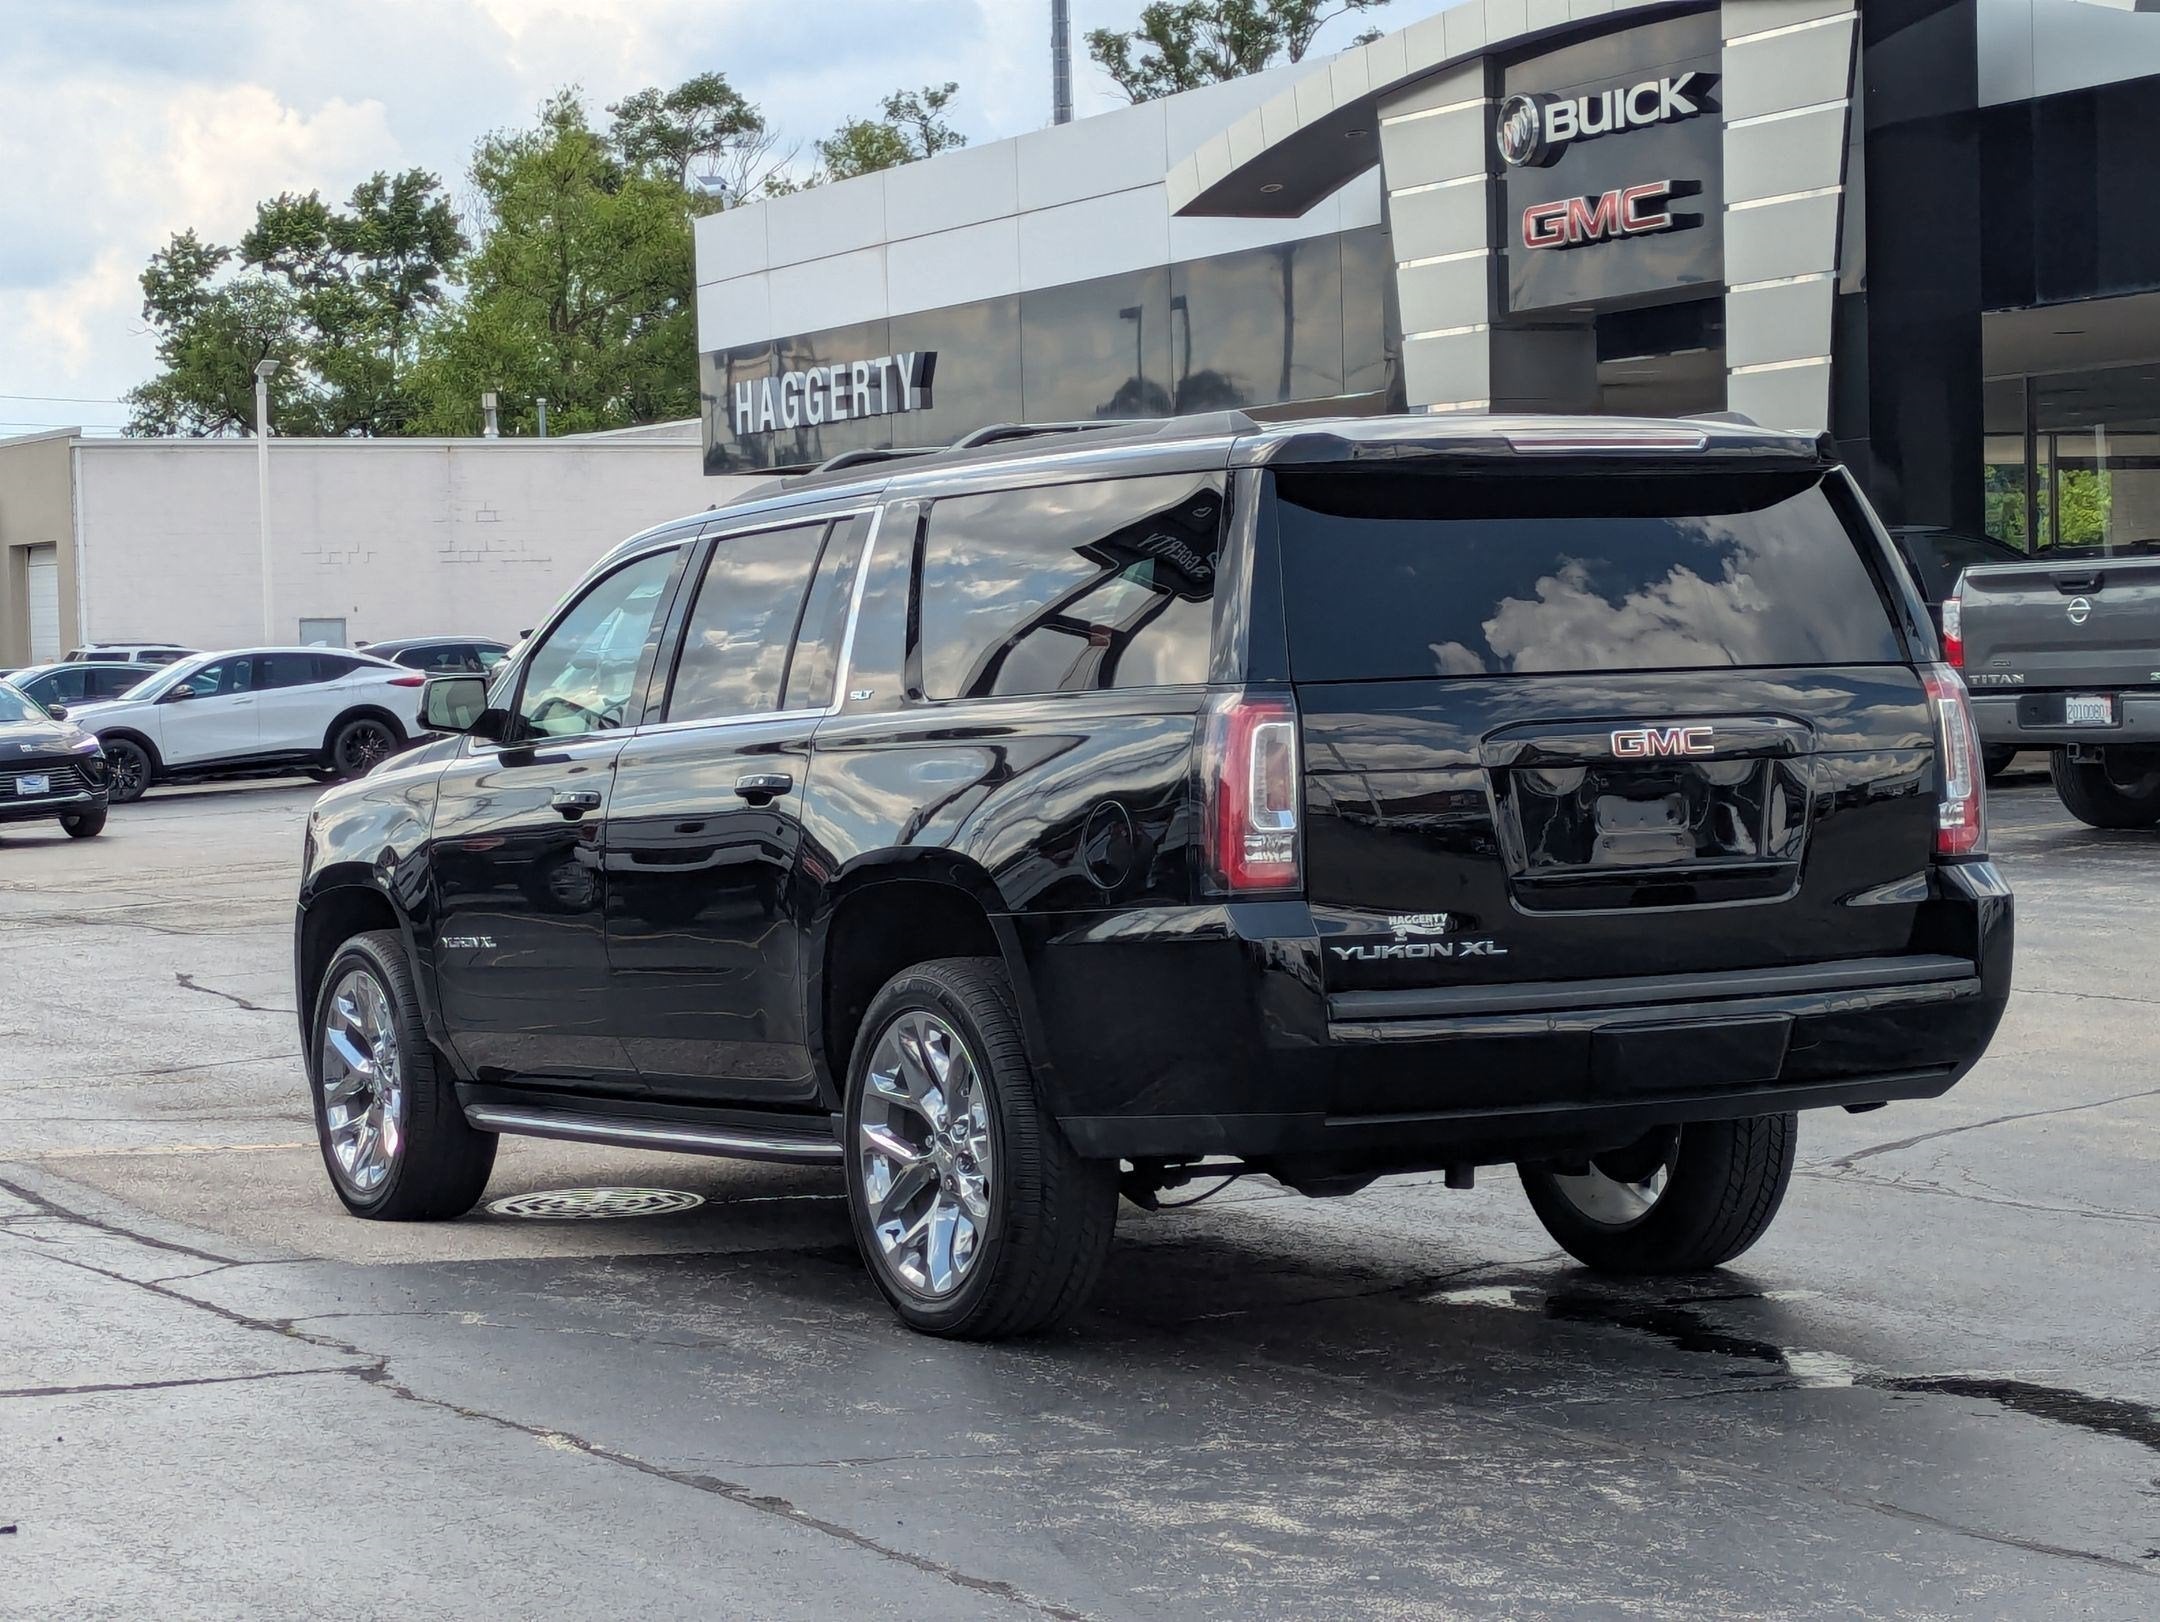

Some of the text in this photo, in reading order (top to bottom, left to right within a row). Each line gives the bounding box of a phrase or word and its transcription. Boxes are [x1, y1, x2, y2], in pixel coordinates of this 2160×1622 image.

[1545, 71, 1698, 143] BUICK
[1523, 180, 1671, 249] GMC
[735, 352, 915, 436] HAGGERTY
[1968, 674, 2025, 684] TITAN
[850, 690, 875, 701] SLT
[1611, 726, 1714, 757] GMC
[1388, 913, 1448, 925] HAGGERTY
[1330, 941, 1509, 960] YUKON XL
